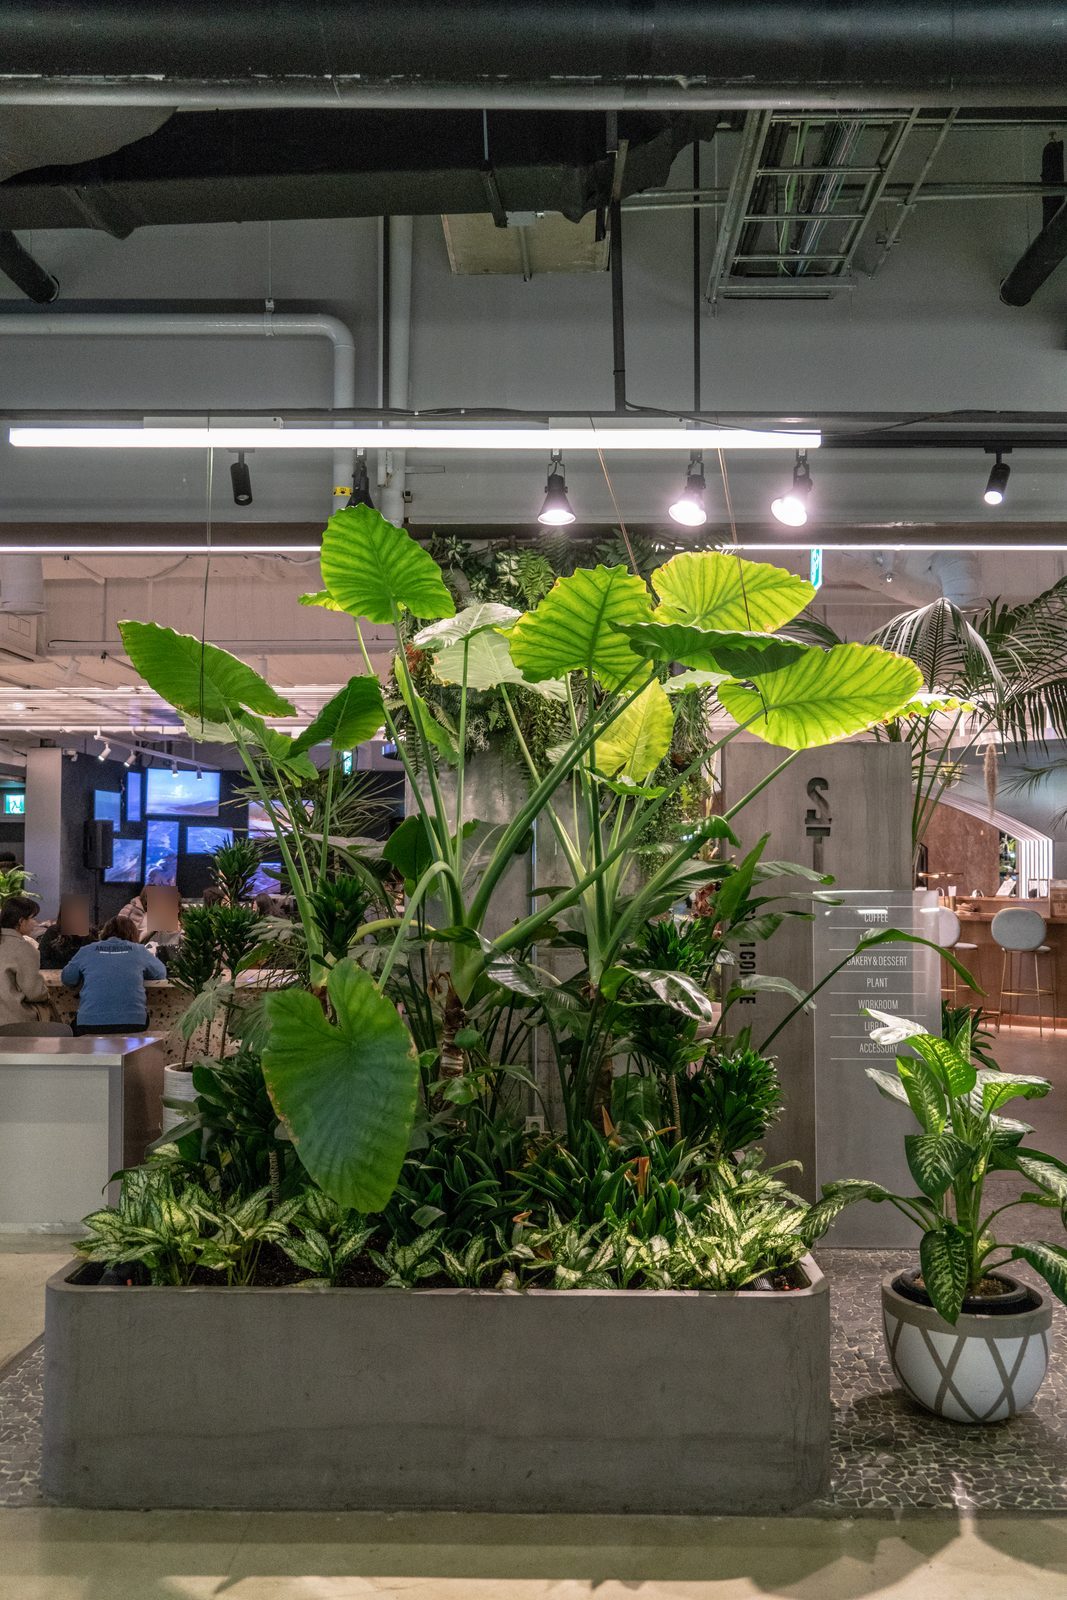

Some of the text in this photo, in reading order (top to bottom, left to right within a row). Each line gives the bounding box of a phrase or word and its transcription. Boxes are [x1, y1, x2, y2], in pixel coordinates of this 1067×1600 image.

[864, 912, 889, 923] COFFEE
[866, 977, 889, 988] PLANT
[858, 999, 899, 1009] WORKROOM
[859, 1043, 899, 1053] ACCESSORY
